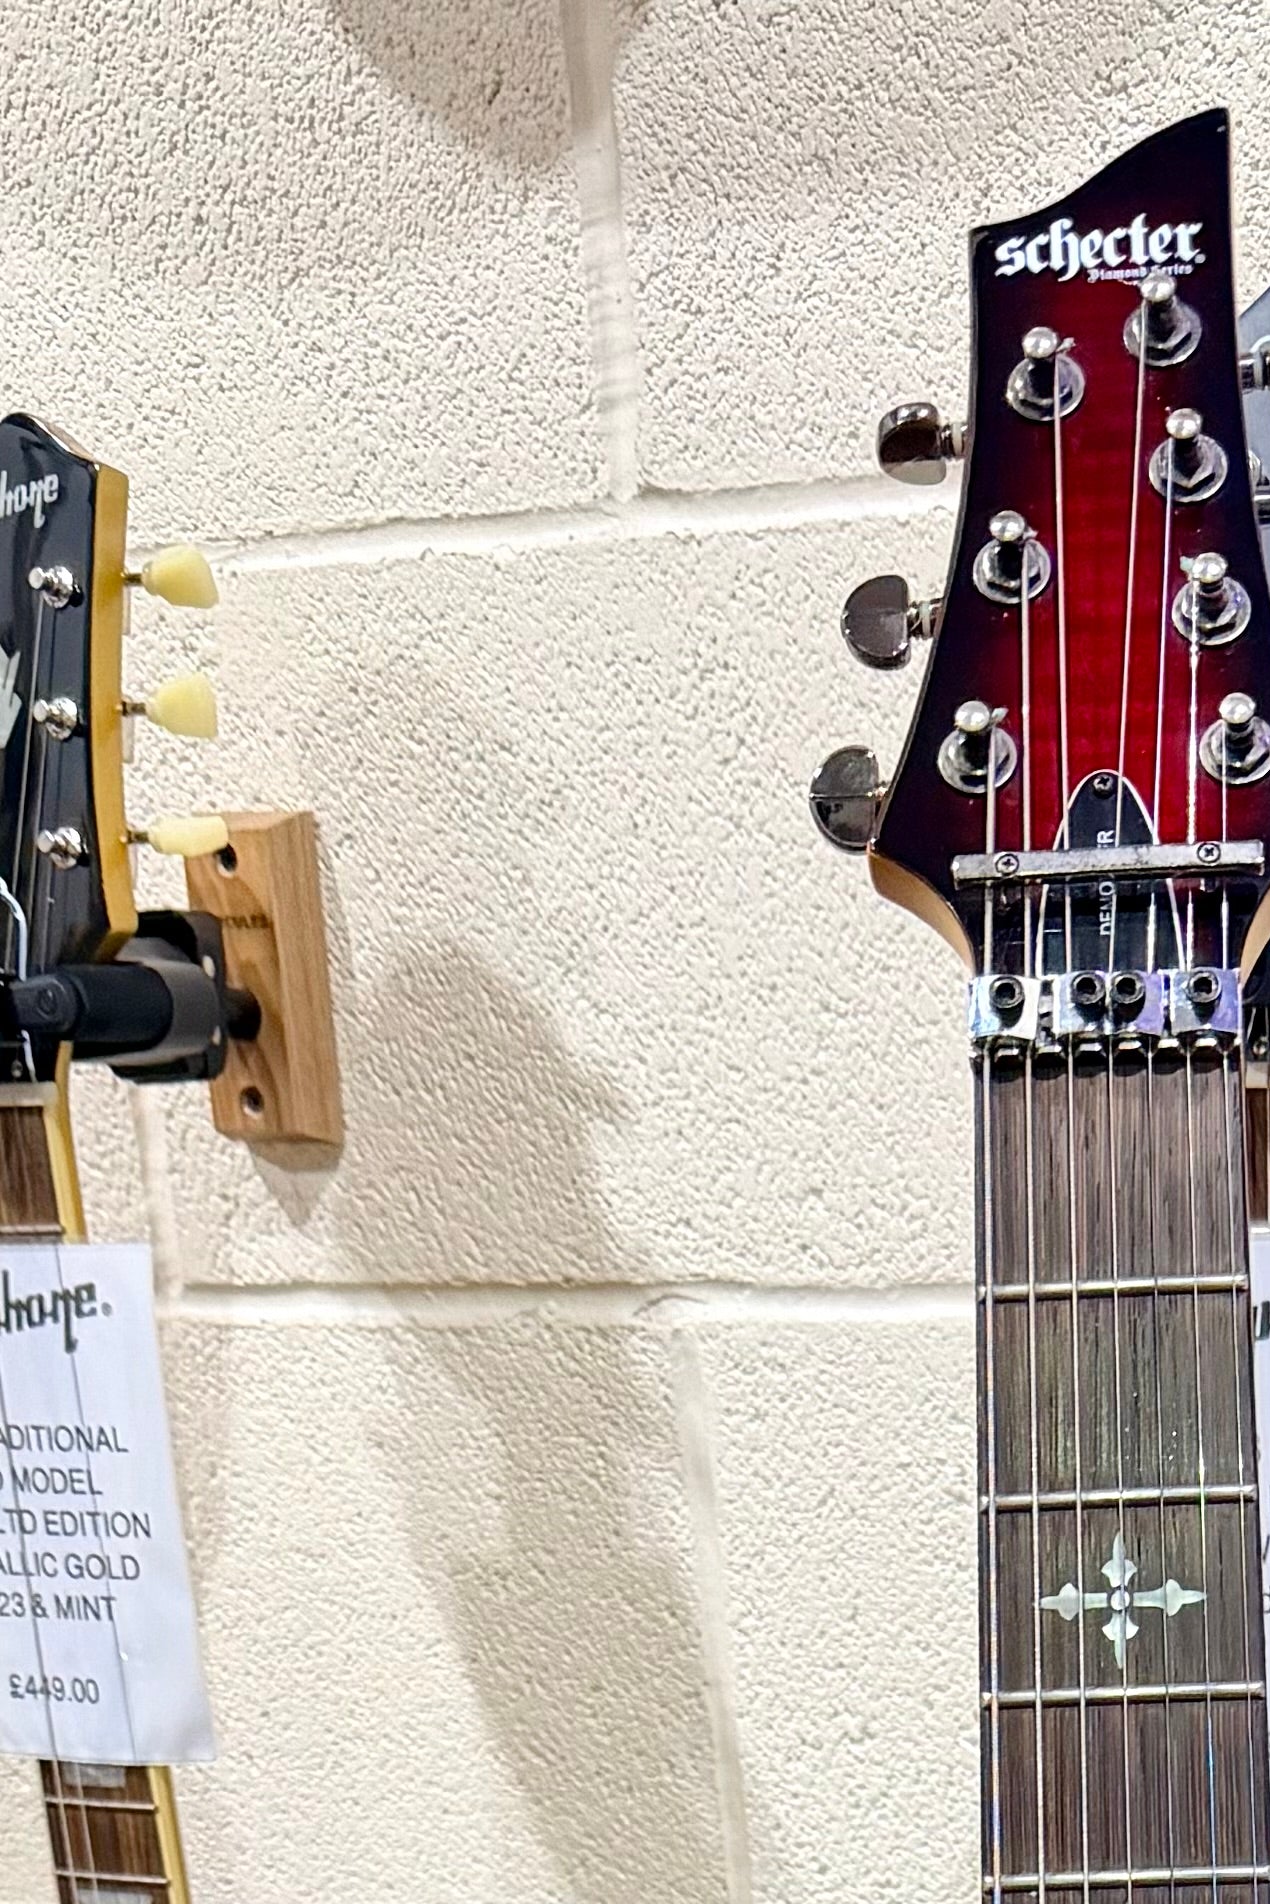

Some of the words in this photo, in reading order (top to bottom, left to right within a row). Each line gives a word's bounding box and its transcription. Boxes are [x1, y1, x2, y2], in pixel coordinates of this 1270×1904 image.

[995, 212, 1203, 282] schecter
[11, 1467, 103, 1495] MODEL
[44, 1510, 151, 1538] EDITION
[65, 1553, 140, 1580] GOLD
[54, 1593, 117, 1622] MINT
